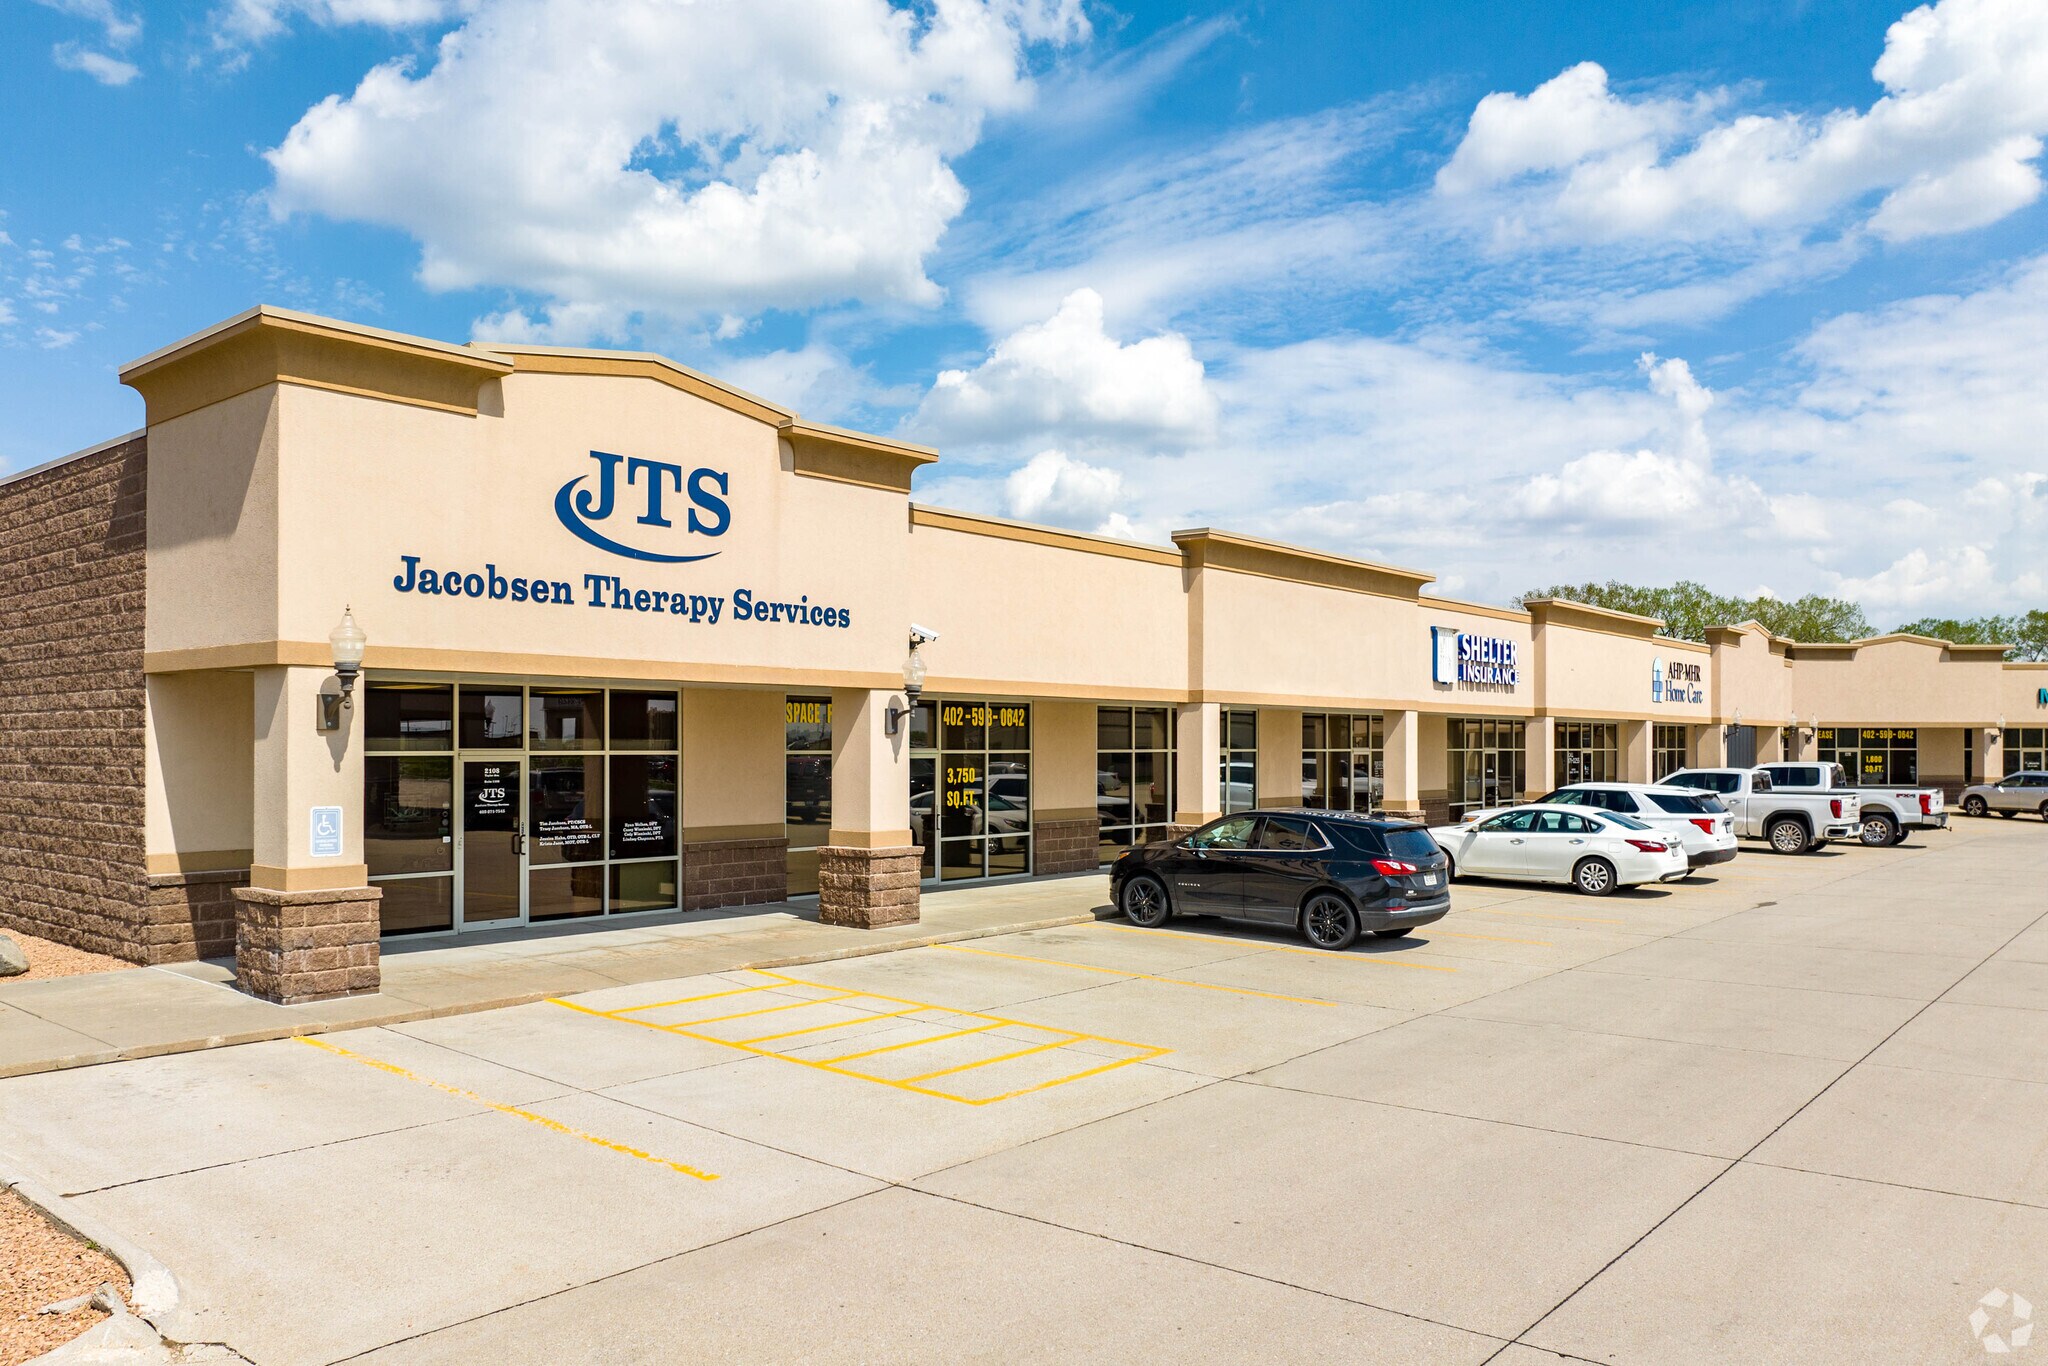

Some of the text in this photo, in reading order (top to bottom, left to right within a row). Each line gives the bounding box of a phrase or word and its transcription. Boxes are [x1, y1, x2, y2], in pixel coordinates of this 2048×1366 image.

[575, 450, 731, 537] JTS
[393, 555, 851, 629] Jacobsen Therapy Services
[1462, 633, 1518, 666] SHELTER
[1462, 663, 1520, 686] INSURANCE
[1665, 680, 1703, 704] Home Care
[786, 702, 820, 724] SPACE
[947, 767, 976, 785] 3,750
[481, 787, 506, 798] JTS
[946, 790, 978, 809] SQ.FT.
